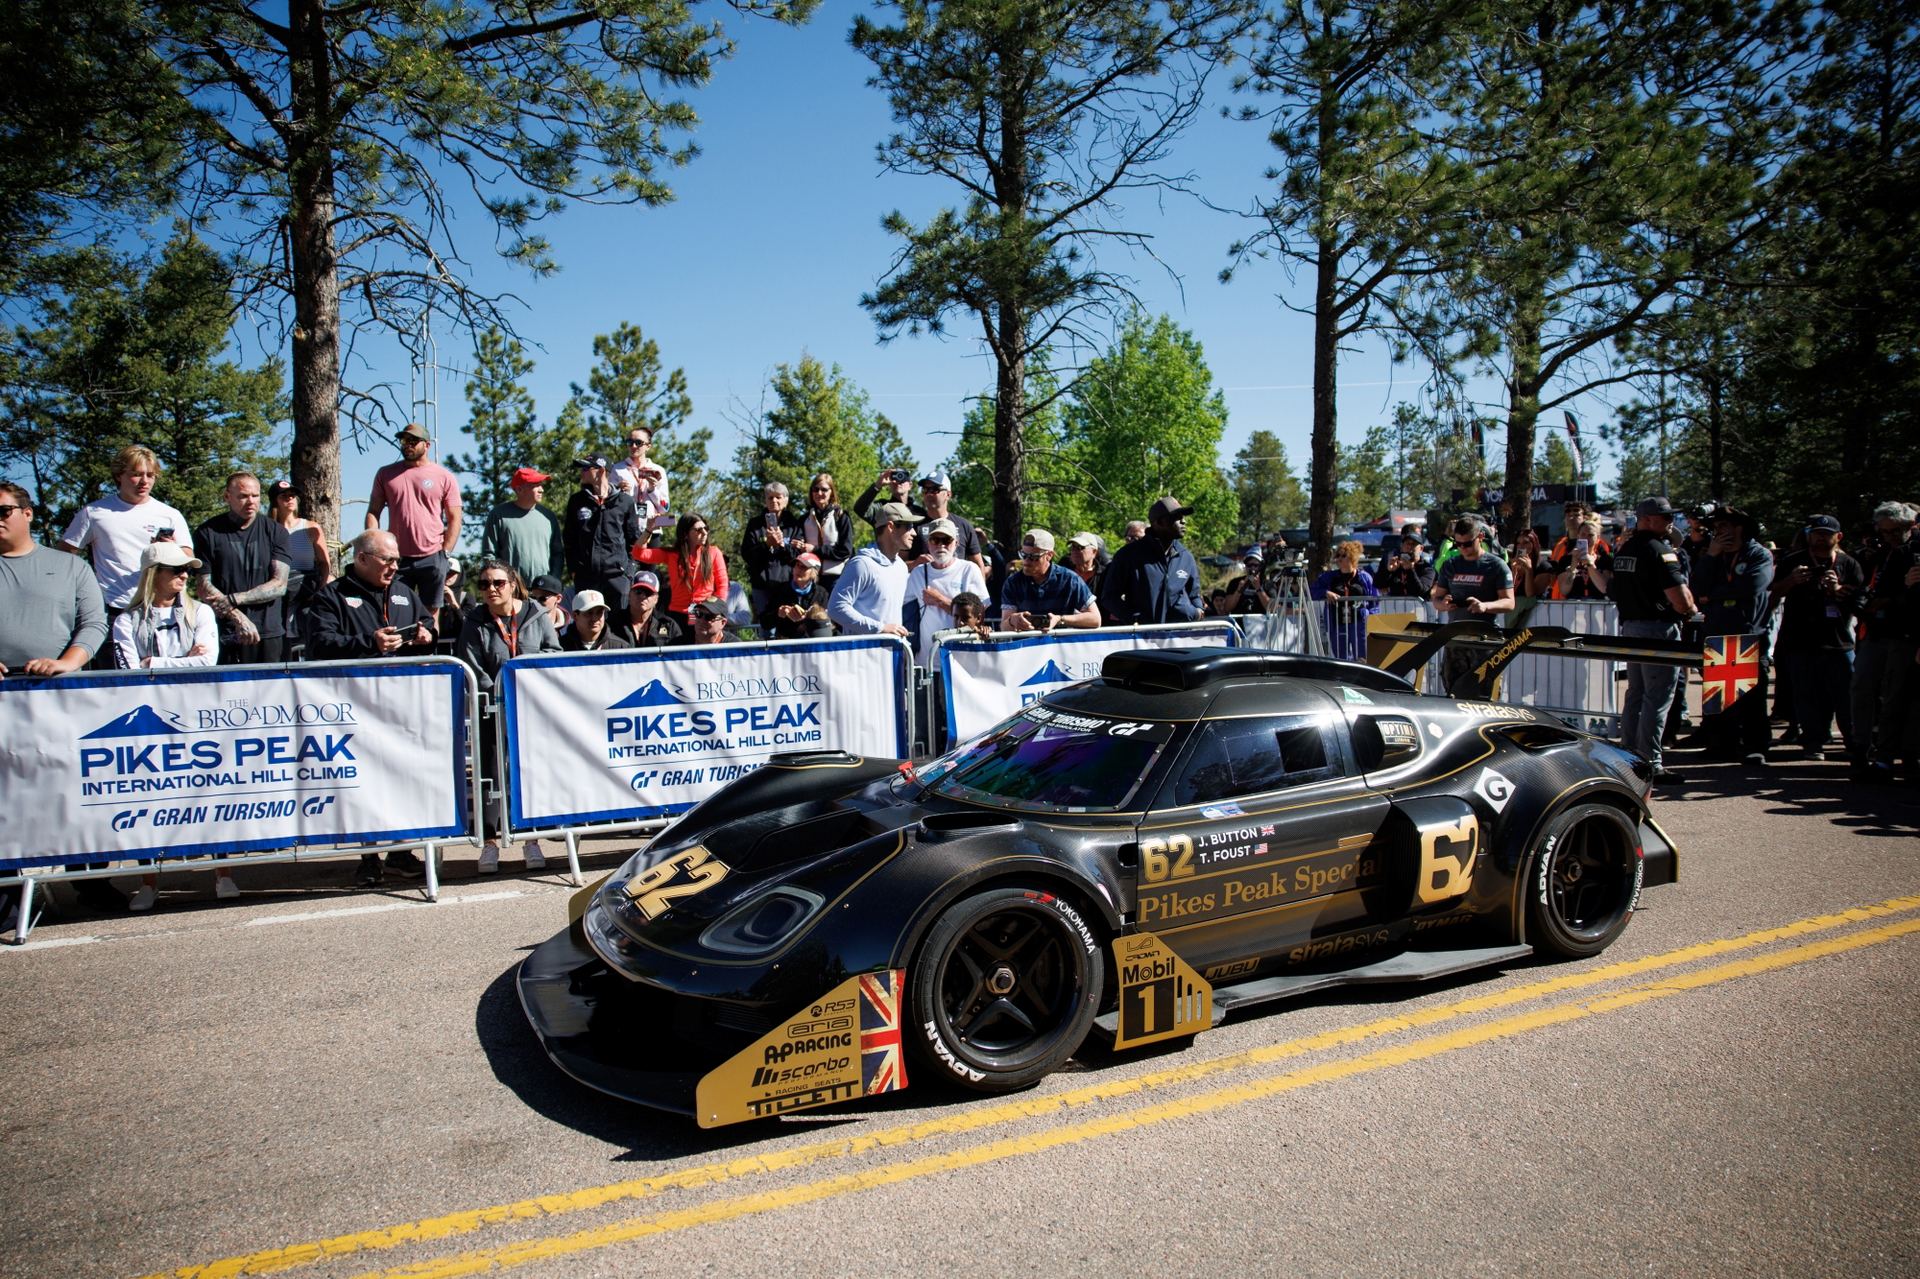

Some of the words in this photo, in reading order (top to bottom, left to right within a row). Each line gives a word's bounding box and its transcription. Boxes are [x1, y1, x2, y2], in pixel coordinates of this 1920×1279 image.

[1453, 574, 1483, 582] JUBU
[1487, 628, 1533, 669] YOKOHAMA
[697, 674, 821, 700] BROADMOOR
[719, 673, 735, 682] THE
[198, 702, 356, 729] BROADMOOR
[227, 698, 249, 708] THE
[1456, 702, 1537, 722] stratasys
[608, 710, 716, 742] PIKES
[726, 701, 820, 733] PEAK
[1052, 713, 1106, 729] TURISMO
[1381, 722, 1416, 737] OPTIMA
[80, 740, 222, 778] PIKES
[235, 733, 356, 766] PEAK
[609, 738, 735, 759] INTERNATIONAL
[739, 734, 770, 749] HILL
[774, 730, 821, 747] CLIMB
[82, 772, 246, 796] INTERNATIONAL
[251, 767, 293, 783] HILL
[297, 764, 358, 781] CLIMB
[661, 768, 704, 787] GRAN
[153, 806, 207, 827] GRAN
[214, 799, 296, 823] TURISMO
[1198, 836, 1209, 848] J.
[1211, 827, 1258, 846] BUTTON
[1142, 834, 1195, 883] 62
[1200, 852, 1210, 864] T.
[1213, 845, 1251, 862] FOUST
[1418, 814, 1479, 904] 62
[622, 845, 732, 921] 62
[1540, 835, 1557, 906] ADVAN
[1137, 891, 1215, 924] Pikes
[1222, 872, 1287, 907] Peak
[1294, 855, 1383, 894] Special
[1628, 859, 1643, 913] YOKOHAMA
[1055, 897, 1096, 954] YOKOHAMA
[1415, 914, 1473, 931] DYMAG
[1288, 930, 1389, 966] stratasys
[1122, 957, 1175, 985] Mobil
[1204, 959, 1258, 980] JUBU
[1137, 985, 1156, 1033] 1
[791, 1019, 849, 1035] aria
[764, 1042, 794, 1065] AP
[794, 1032, 852, 1051] RACING
[924, 1020, 987, 1082] ADVAN
[778, 1069, 844, 1085] PERFORMANCE
[780, 1056, 850, 1082] scarbo
[747, 1079, 859, 1116] TILLETT
[775, 1084, 808, 1095] RACING
[815, 1077, 842, 1087] SEATS
